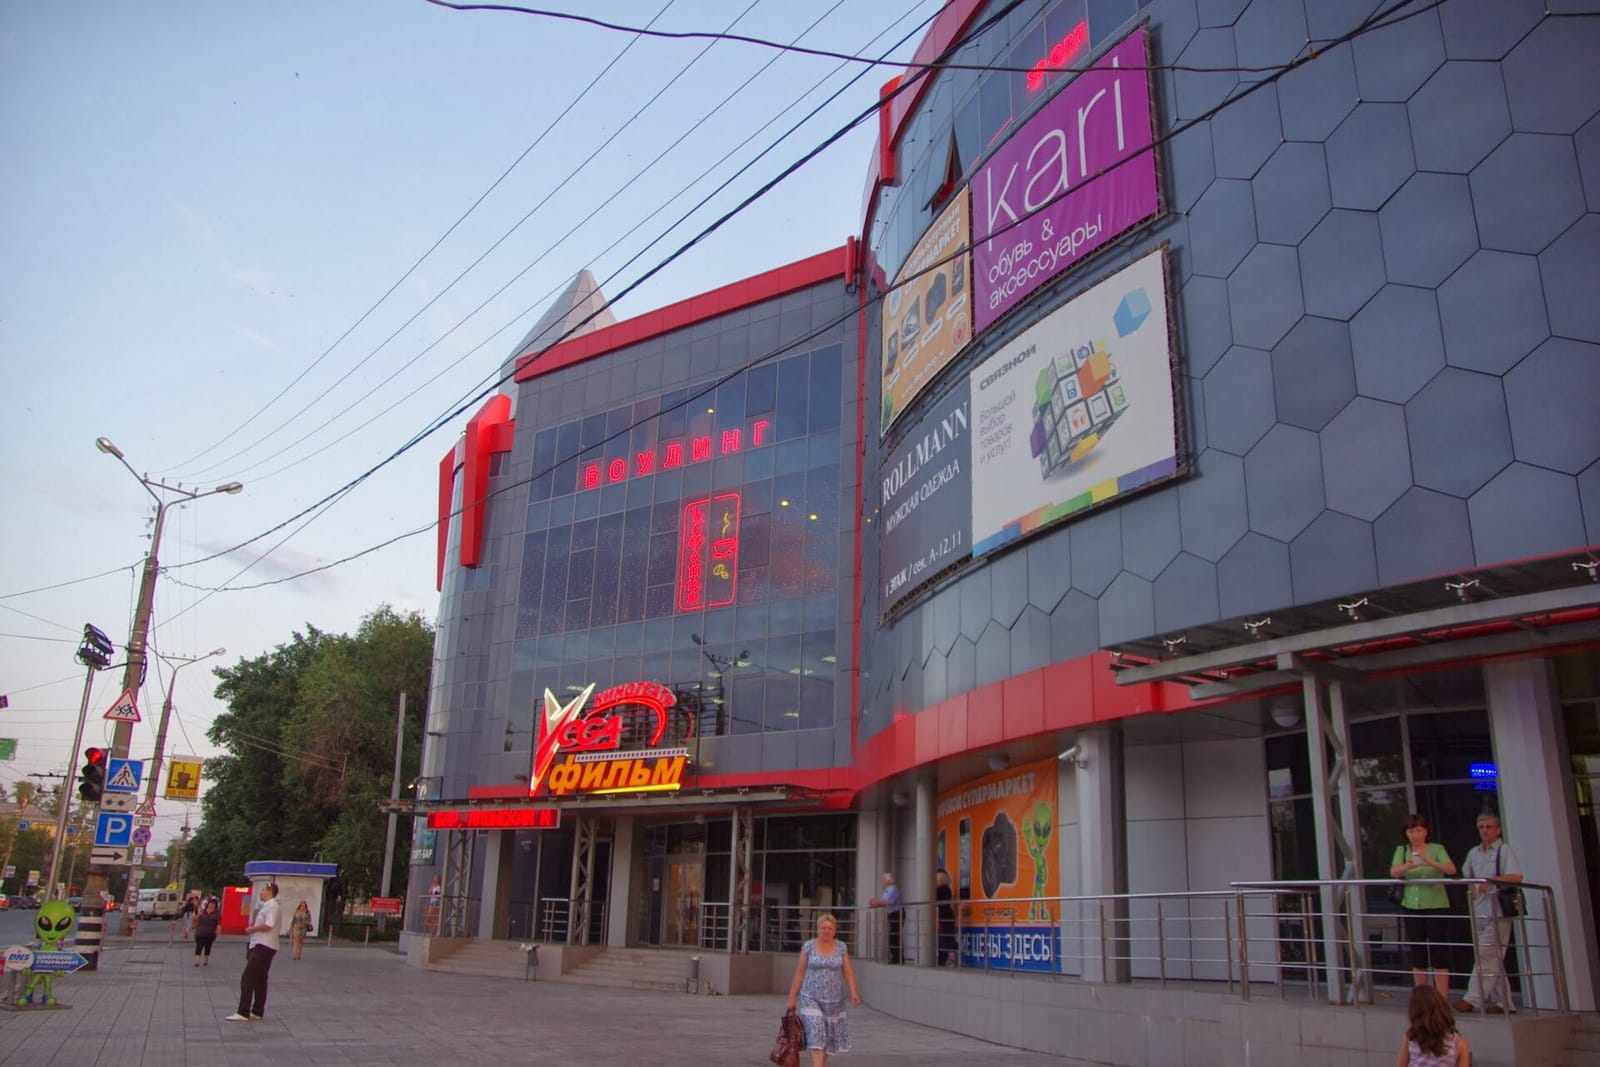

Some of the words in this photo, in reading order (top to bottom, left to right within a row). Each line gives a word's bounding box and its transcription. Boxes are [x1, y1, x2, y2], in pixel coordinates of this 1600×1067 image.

[986, 56, 1125, 252] kari
[988, 239, 1033, 283] обувь
[1041, 218, 1055, 241] &
[989, 213, 1102, 310] аксессуары
[585, 420, 769, 489] БОУЛИНГ
[882, 401, 969, 507] ROLLMANN
[886, 490, 920, 535] МУЖСКАЯ
[920, 459, 960, 501] ОДЕЖДА
[963, 772, 1036, 808] СУПЕРМАРКЕТ
[104, 817, 127, 843] P
[8, 953, 31, 961] DNS
